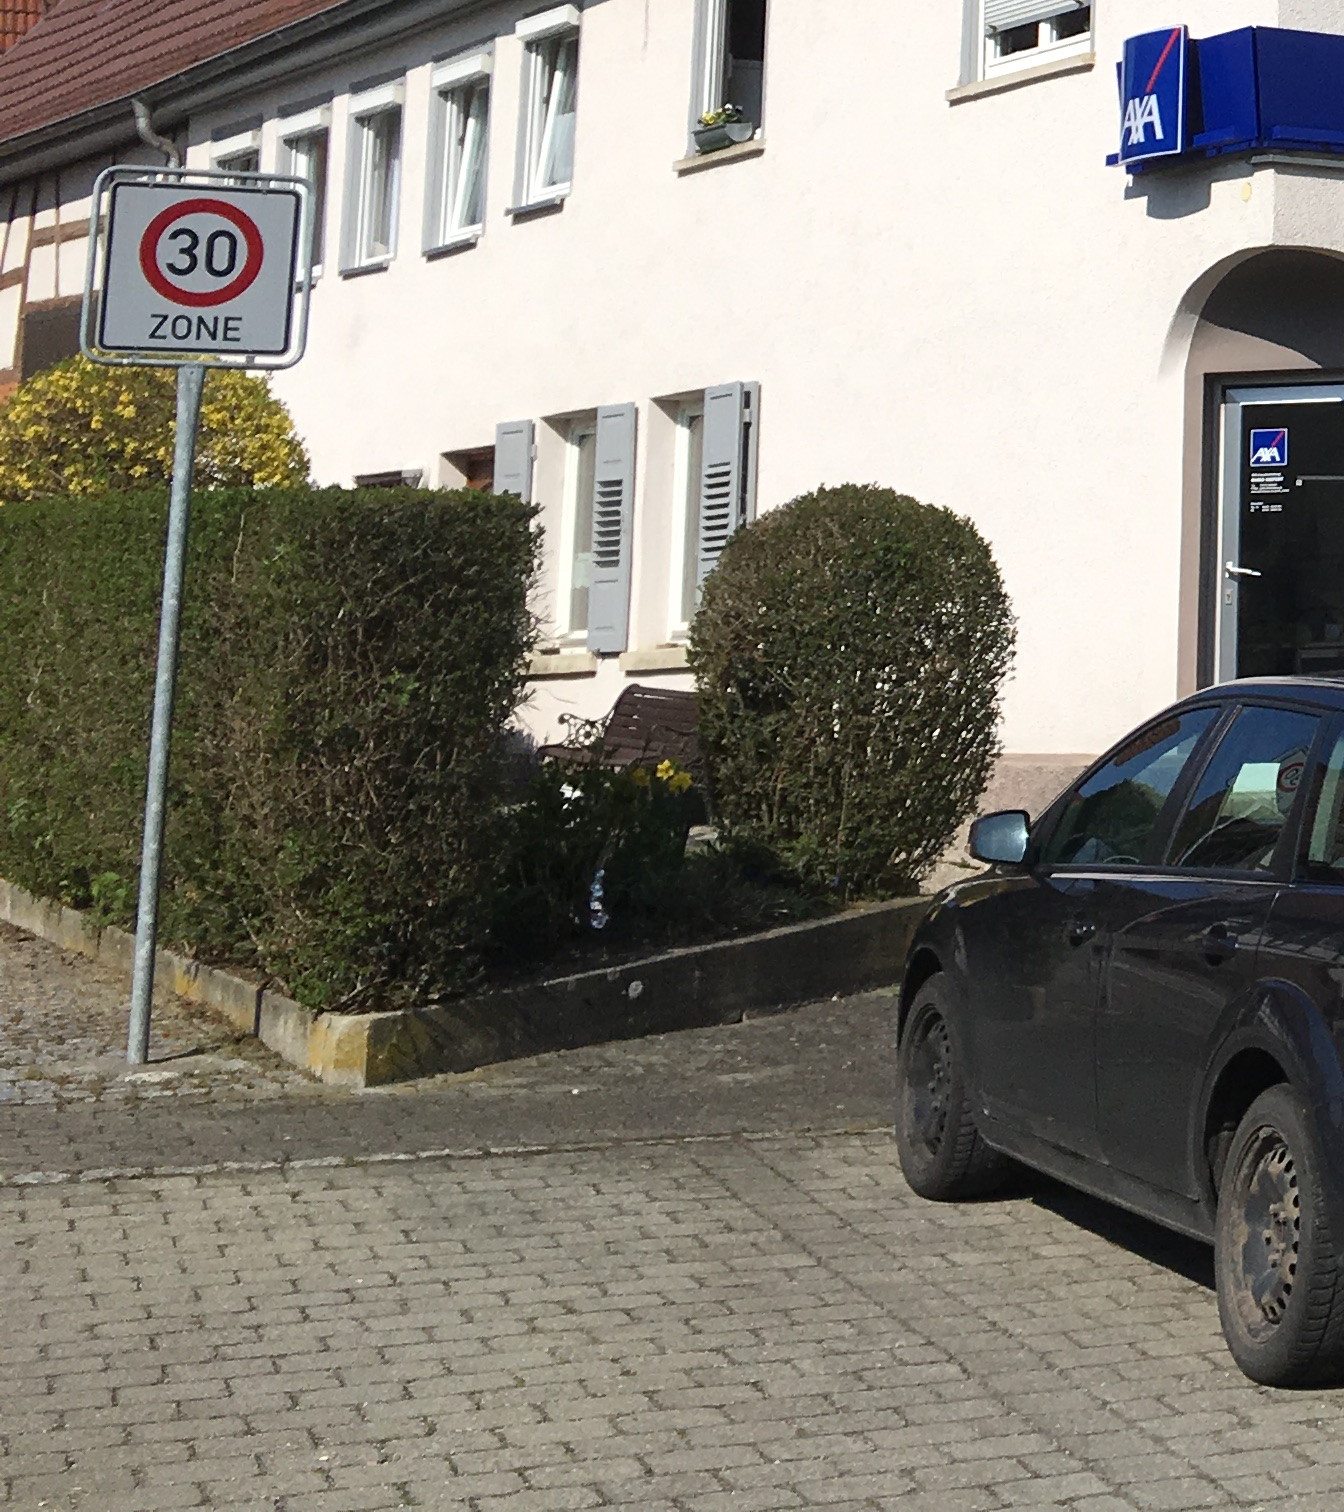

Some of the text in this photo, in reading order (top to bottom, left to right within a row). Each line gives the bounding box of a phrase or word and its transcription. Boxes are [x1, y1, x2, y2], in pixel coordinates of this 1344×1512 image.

[1120, 94, 1164, 145] AXA
[166, 227, 238, 278] 30
[148, 313, 243, 342] ZONE
[1250, 447, 1281, 463] AXA
